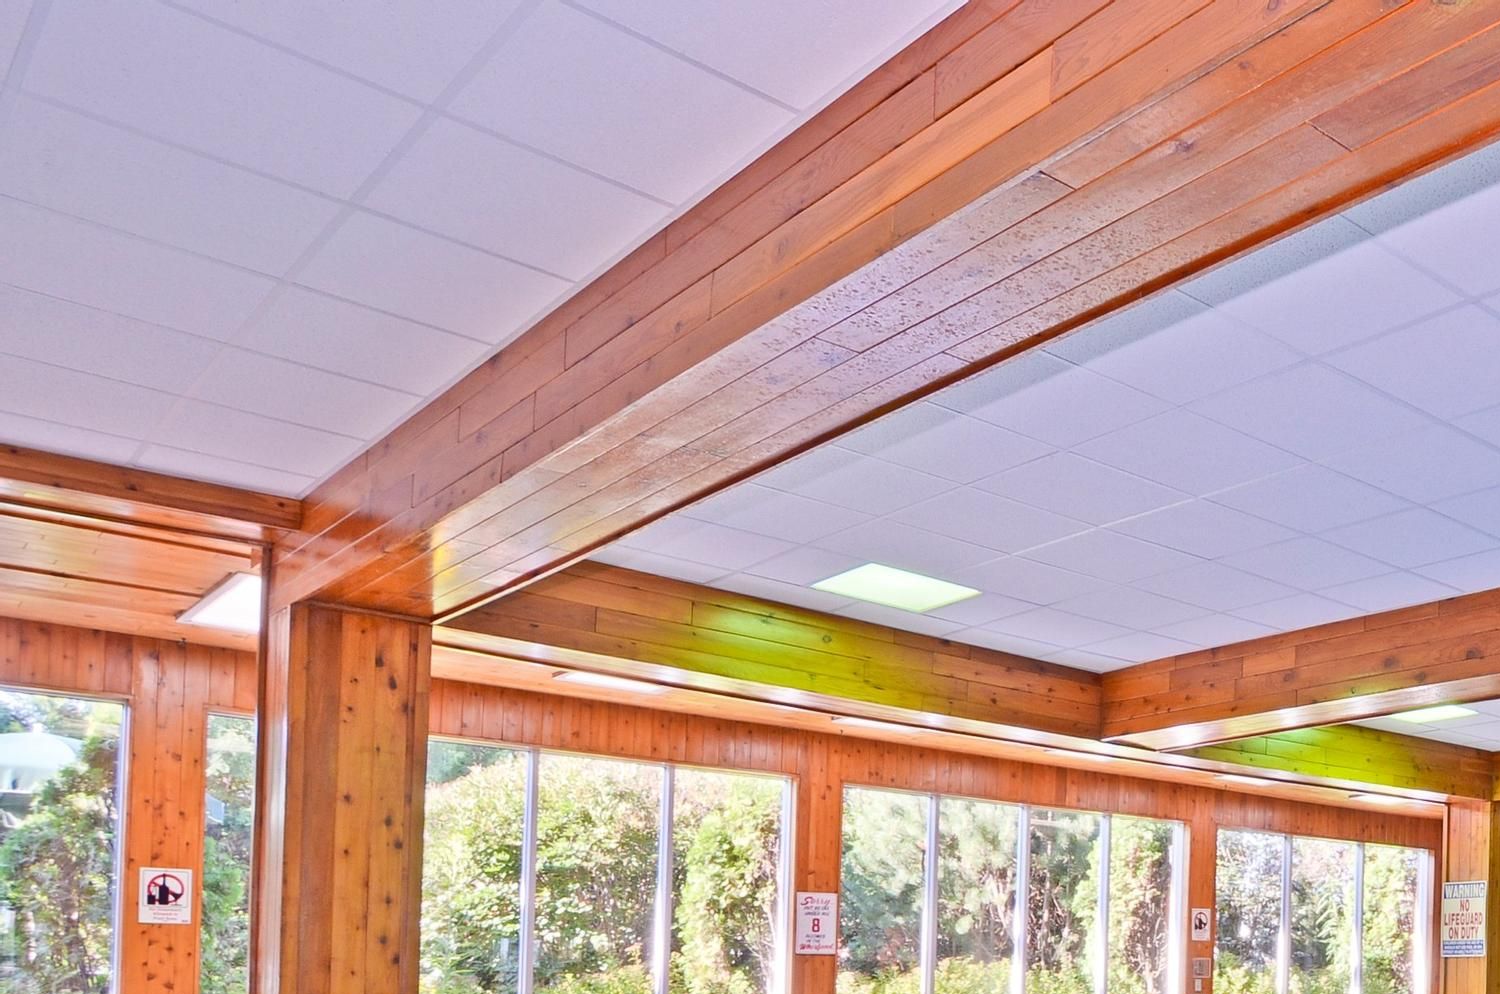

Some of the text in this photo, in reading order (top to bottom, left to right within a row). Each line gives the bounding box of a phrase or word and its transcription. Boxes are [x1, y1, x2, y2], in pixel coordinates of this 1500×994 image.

[1445, 883, 1485, 898] WARNING
[1459, 899, 1470, 912] NO
[812, 918, 820, 932] 8
[1444, 912, 1483, 926] LIFEGUARD
[1448, 926, 1479, 940] ON DUTY
